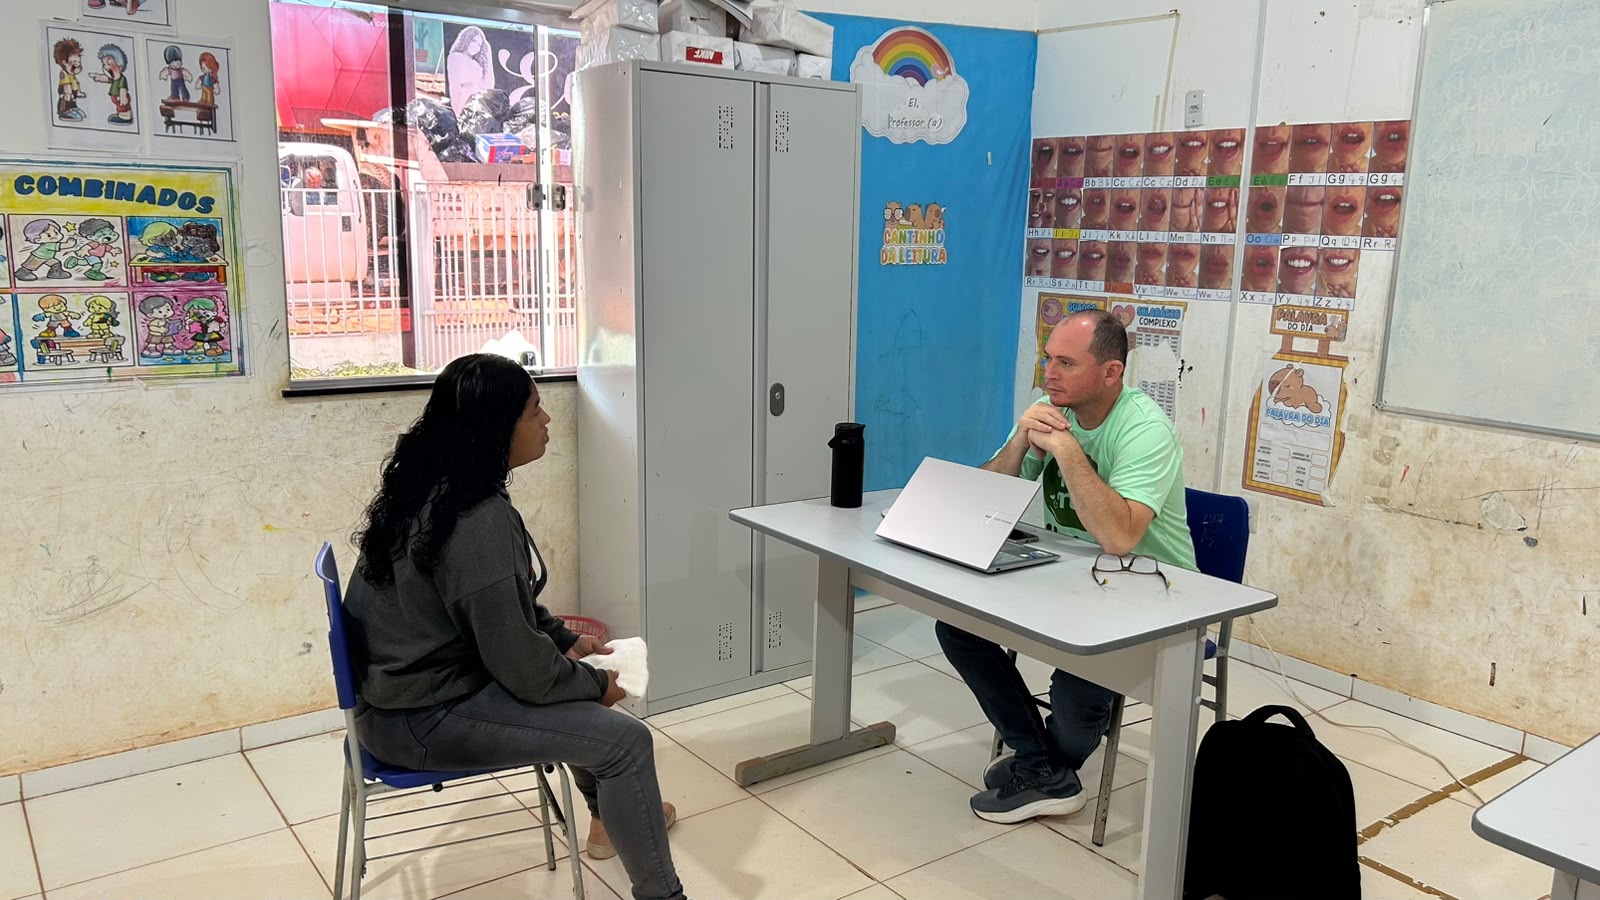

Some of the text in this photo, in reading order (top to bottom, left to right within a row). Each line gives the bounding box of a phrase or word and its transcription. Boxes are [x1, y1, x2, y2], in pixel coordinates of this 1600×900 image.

[888, 116, 942, 129] Professor (a)
[1144, 178, 1155, 186] Cc
[1176, 178, 1188, 186] Dd
[1328, 174, 1345, 184] Gg
[1370, 174, 1387, 184] Gg
[14, 176, 215, 214] COMBINADOS
[884, 229, 944, 244] CANTINHO
[1283, 235, 1296, 243] Pp
[1322, 236, 1336, 246] Qq
[881, 248, 946, 264] DA LEITURA
[1316, 298, 1331, 306] Zz
[1139, 318, 1177, 328] COMPLEXO
[1277, 310, 1327, 326] PALAVRA
[1266, 408, 1330, 426] PALAVRA DO DIA
